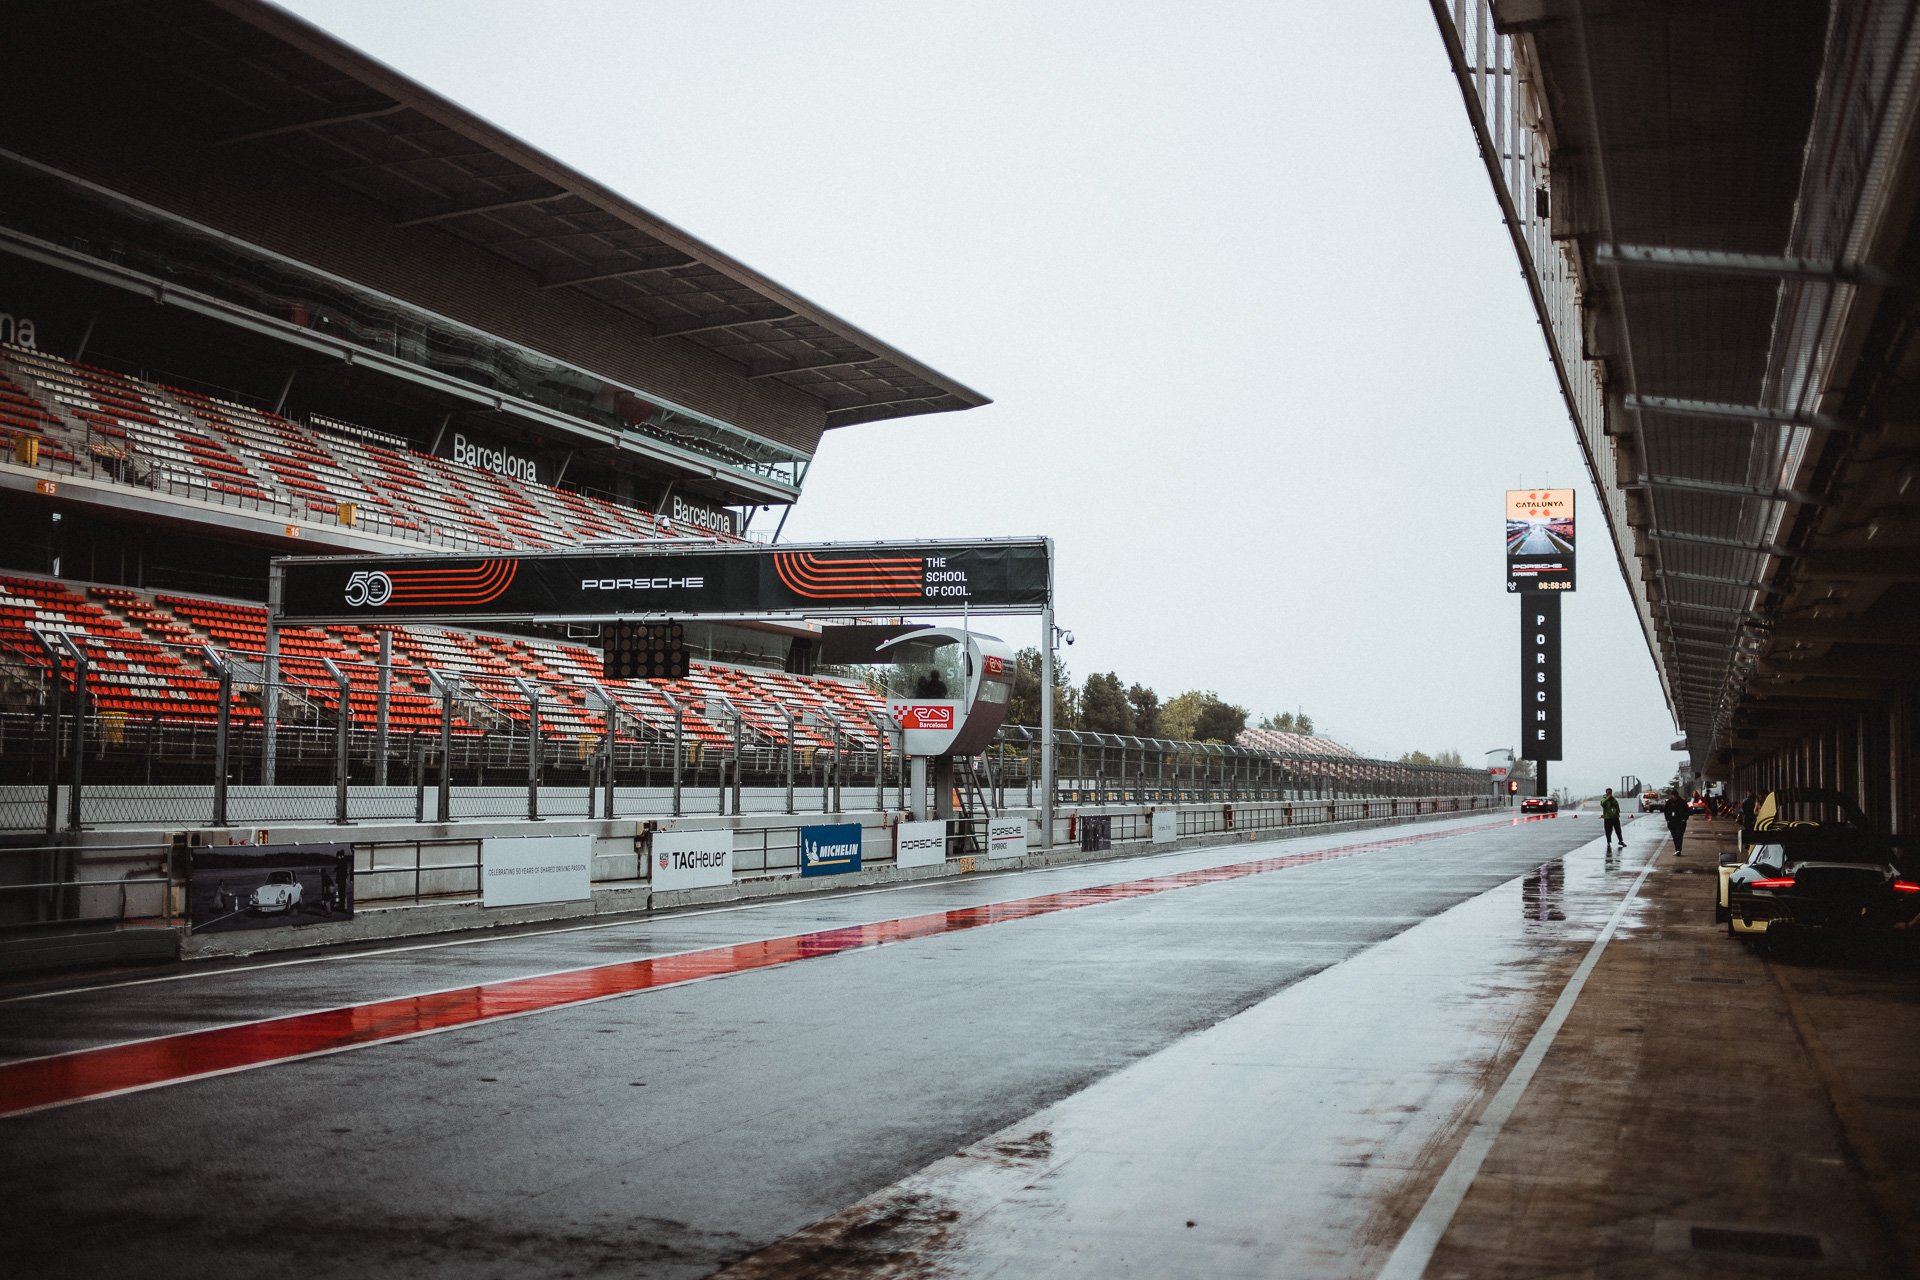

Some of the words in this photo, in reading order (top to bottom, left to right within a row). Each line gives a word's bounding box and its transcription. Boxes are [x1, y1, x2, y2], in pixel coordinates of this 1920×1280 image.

[454, 433, 536, 482] Barcelona
[44, 482, 56, 494] 15
[673, 495, 731, 533] Barcelona
[291, 527, 299, 537] 16
[926, 557, 946, 568] THE
[926, 571, 968, 582] SCHOOL
[345, 571, 393, 607] 50
[582, 577, 704, 590] PORSCHE
[926, 586, 939, 597] OF
[941, 586, 971, 597] COOL.
[1537, 614, 1545, 741] PORSCHE
[992, 826, 1021, 836] PORSCHE
[901, 838, 942, 850] PORSCHE
[820, 844, 859, 858] MICHELIN
[488, 868, 515, 876] CELEBRATING
[516, 867, 521, 875] 50
[521, 867, 534, 875] YEARS
[540, 865, 555, 873] SHARED
[555, 864, 571, 872] DRIVING
